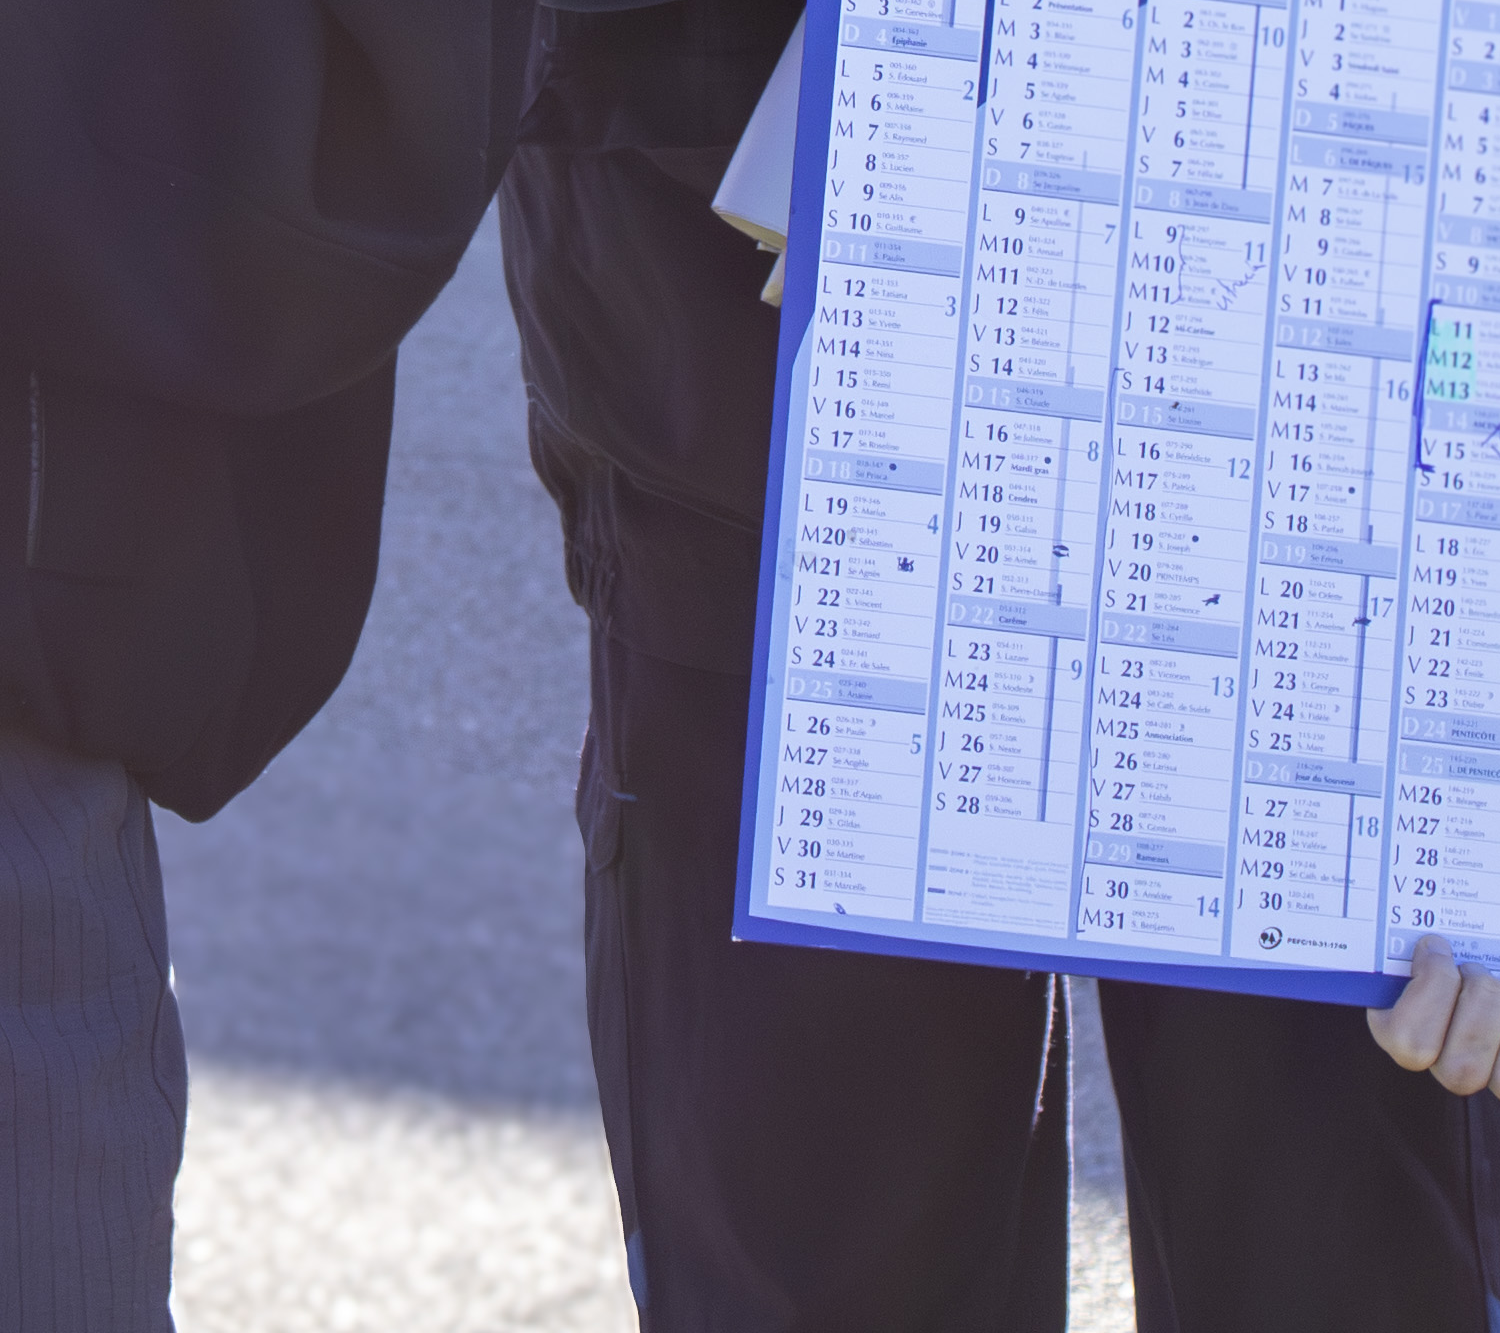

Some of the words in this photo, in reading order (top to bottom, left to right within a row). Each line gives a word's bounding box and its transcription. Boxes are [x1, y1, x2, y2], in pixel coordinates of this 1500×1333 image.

[1300, 48, 1315, 68] V
[1331, 53, 1344, 72] 3
[990, 107, 1004, 126] V
[1022, 112, 1034, 130] 6
[828, 209, 838, 226] S
[850, 212, 872, 232] 10
[1125, 341, 1139, 360] V
[1146, 345, 1168, 365] 13
[970, 353, 980, 373] S
[991, 357, 1014, 377] 14
[812, 396, 827, 415] V
[834, 399, 857, 419] 16
[1087, 440, 1100, 462] 8
[1010, 463, 1033, 473] Mardi
[1228, 458, 1251, 480] 12
[1008, 493, 1038, 504] Cendres
[1265, 510, 1275, 529] S
[1286, 513, 1308, 534] 18
[1105, 589, 1116, 608] S
[1125, 592, 1147, 612] 21
[1371, 597, 1394, 619] 17
[791, 646, 802, 665] S
[812, 648, 836, 669] 24
[1407, 655, 1422, 675] V
[1427, 658, 1451, 678] 22
[1070, 659, 1083, 681] 9
[1211, 676, 1235, 699] 13
[1251, 698, 1266, 718] V
[1271, 701, 1295, 722] 24
[909, 733, 922, 755] 5
[935, 791, 946, 811] S
[956, 795, 980, 815] 28
[777, 836, 792, 855] V
[798, 839, 822, 859] 30
[1196, 896, 1220, 918] 14
[1391, 905, 1402, 924] S
[1411, 908, 1436, 928] 30
